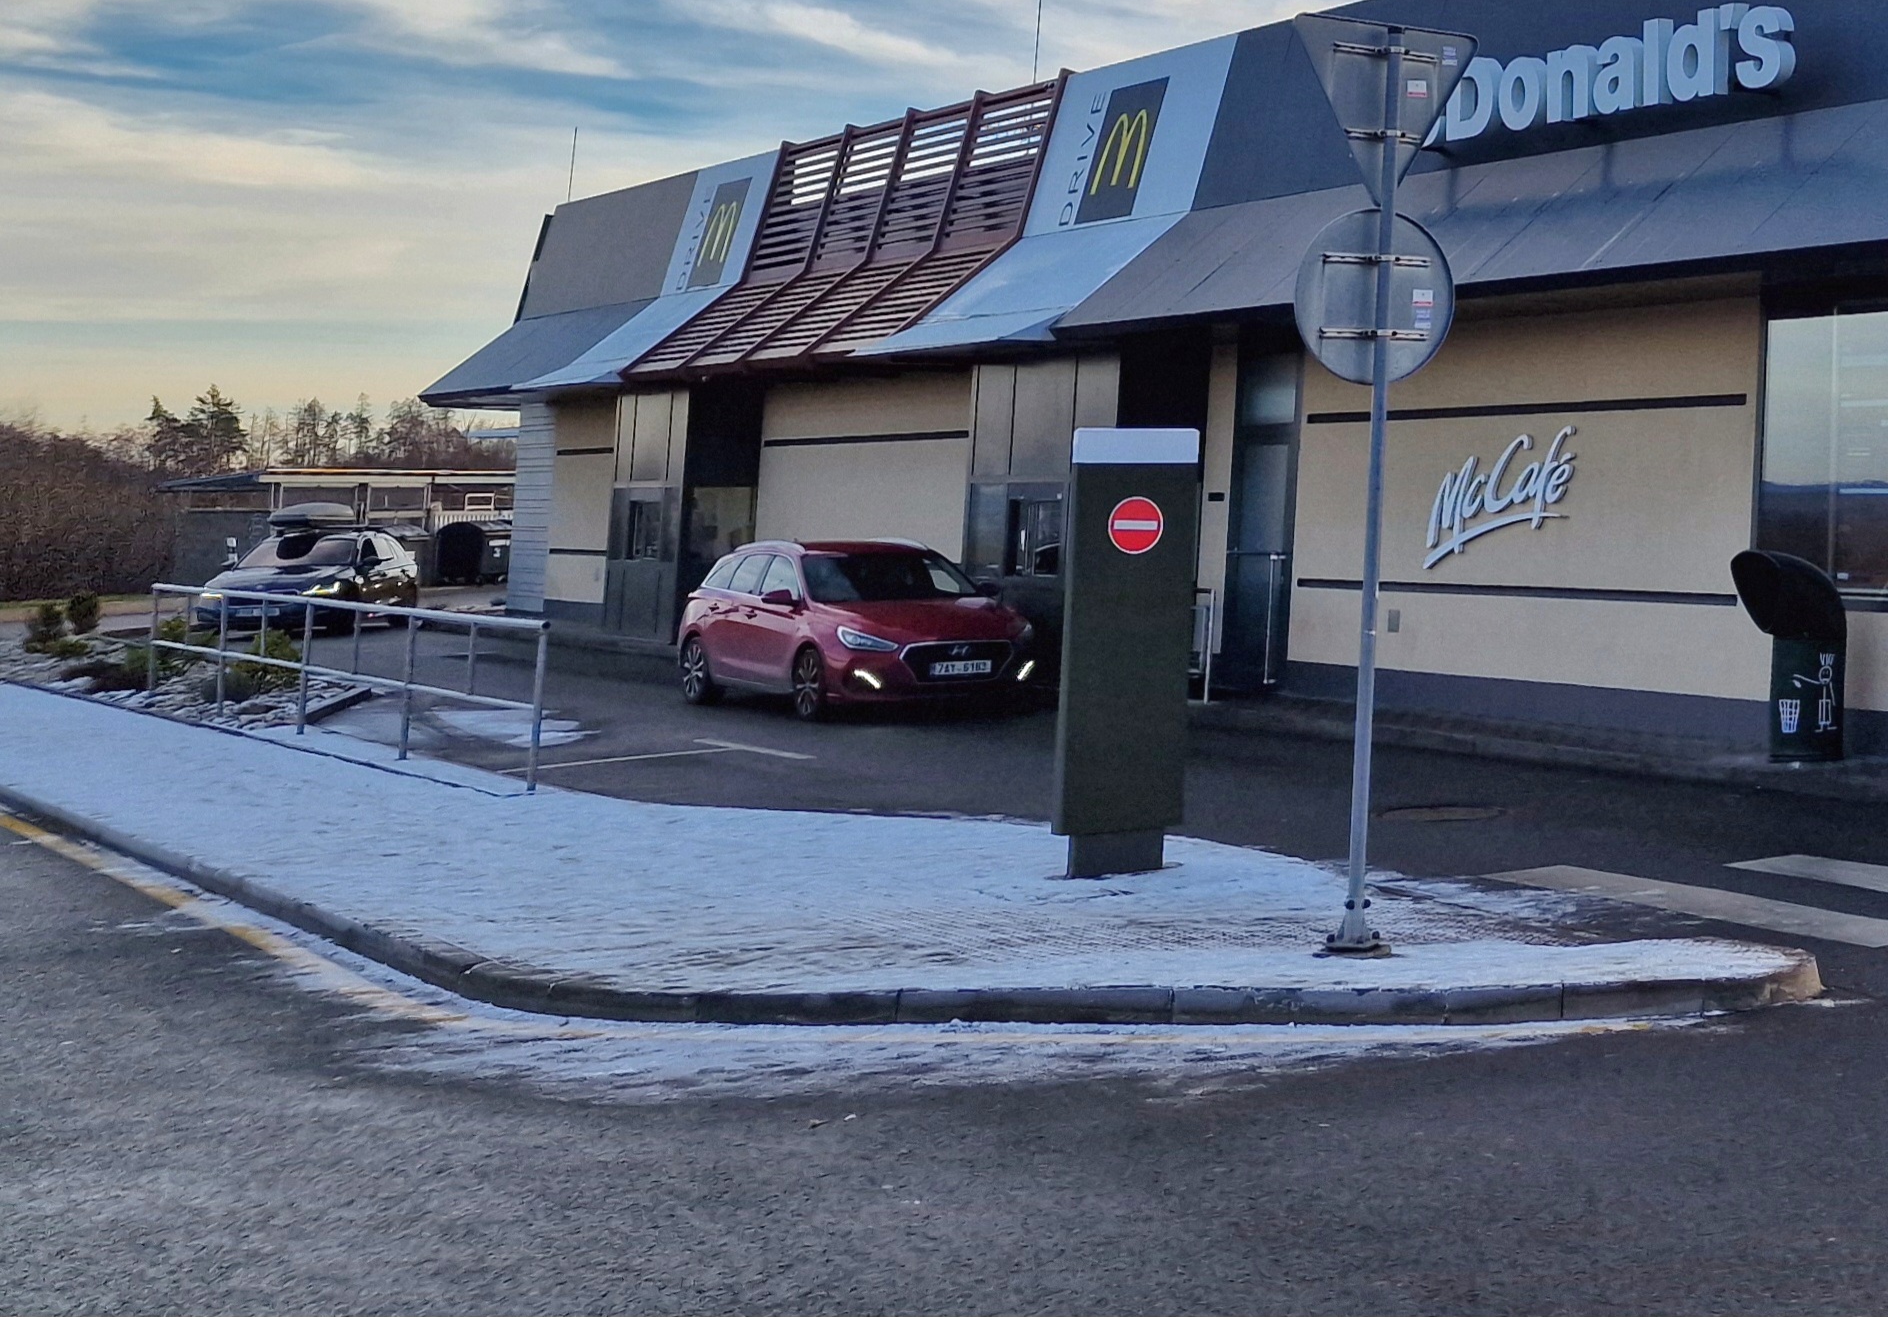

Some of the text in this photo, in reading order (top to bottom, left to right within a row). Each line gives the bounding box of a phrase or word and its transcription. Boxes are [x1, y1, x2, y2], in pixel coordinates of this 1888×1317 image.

[1421, 2, 1797, 149] Donald's
[1058, 91, 1107, 227] DRIVE
[1425, 425, 1577, 556] McCafé
